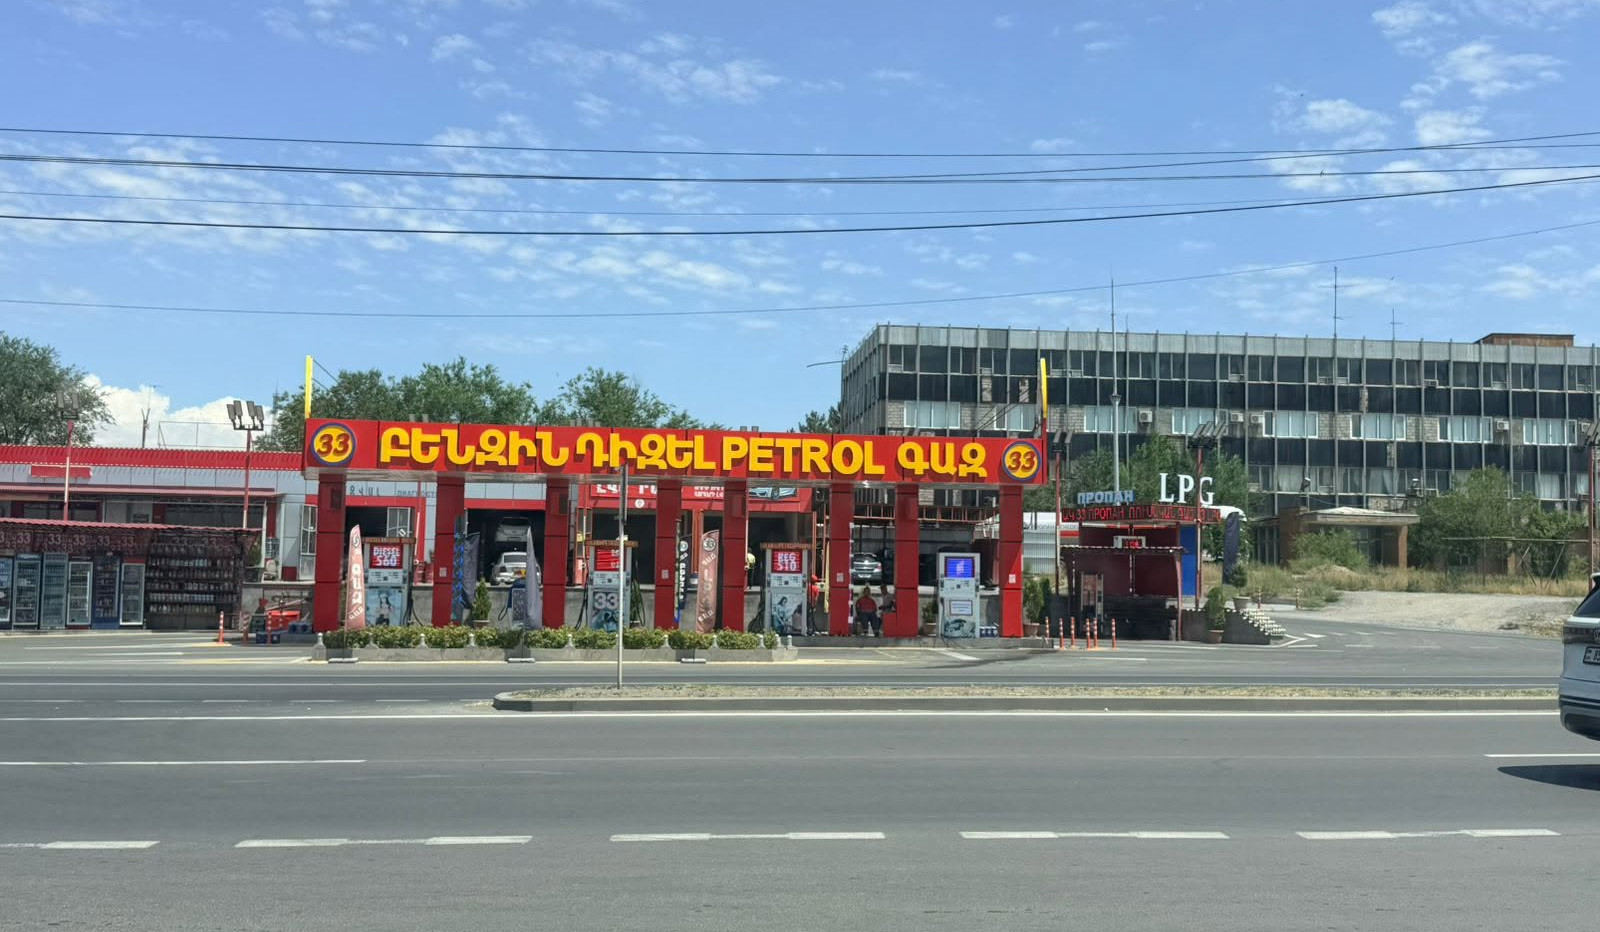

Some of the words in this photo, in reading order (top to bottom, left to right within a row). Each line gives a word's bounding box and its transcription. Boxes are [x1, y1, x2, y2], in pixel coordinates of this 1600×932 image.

[316, 433, 350, 457] 33
[380, 427, 570, 466] ԲԵՆԶԻՆ
[576, 431, 717, 470] ԴԻԶԵԼ
[722, 436, 885, 475] PETROL
[897, 441, 988, 478] ԳԱԶ
[1008, 450, 1036, 472] 33
[1158, 472, 1215, 505] LPG
[1077, 490, 1135, 505] ПРОПАН
[48, 533, 62, 545] 33
[73, 534, 87, 546] 33
[97, 535, 111, 547] 33
[373, 546, 400, 557] DIESEL
[375, 556, 398, 567] 560
[594, 592, 619, 609] 33
